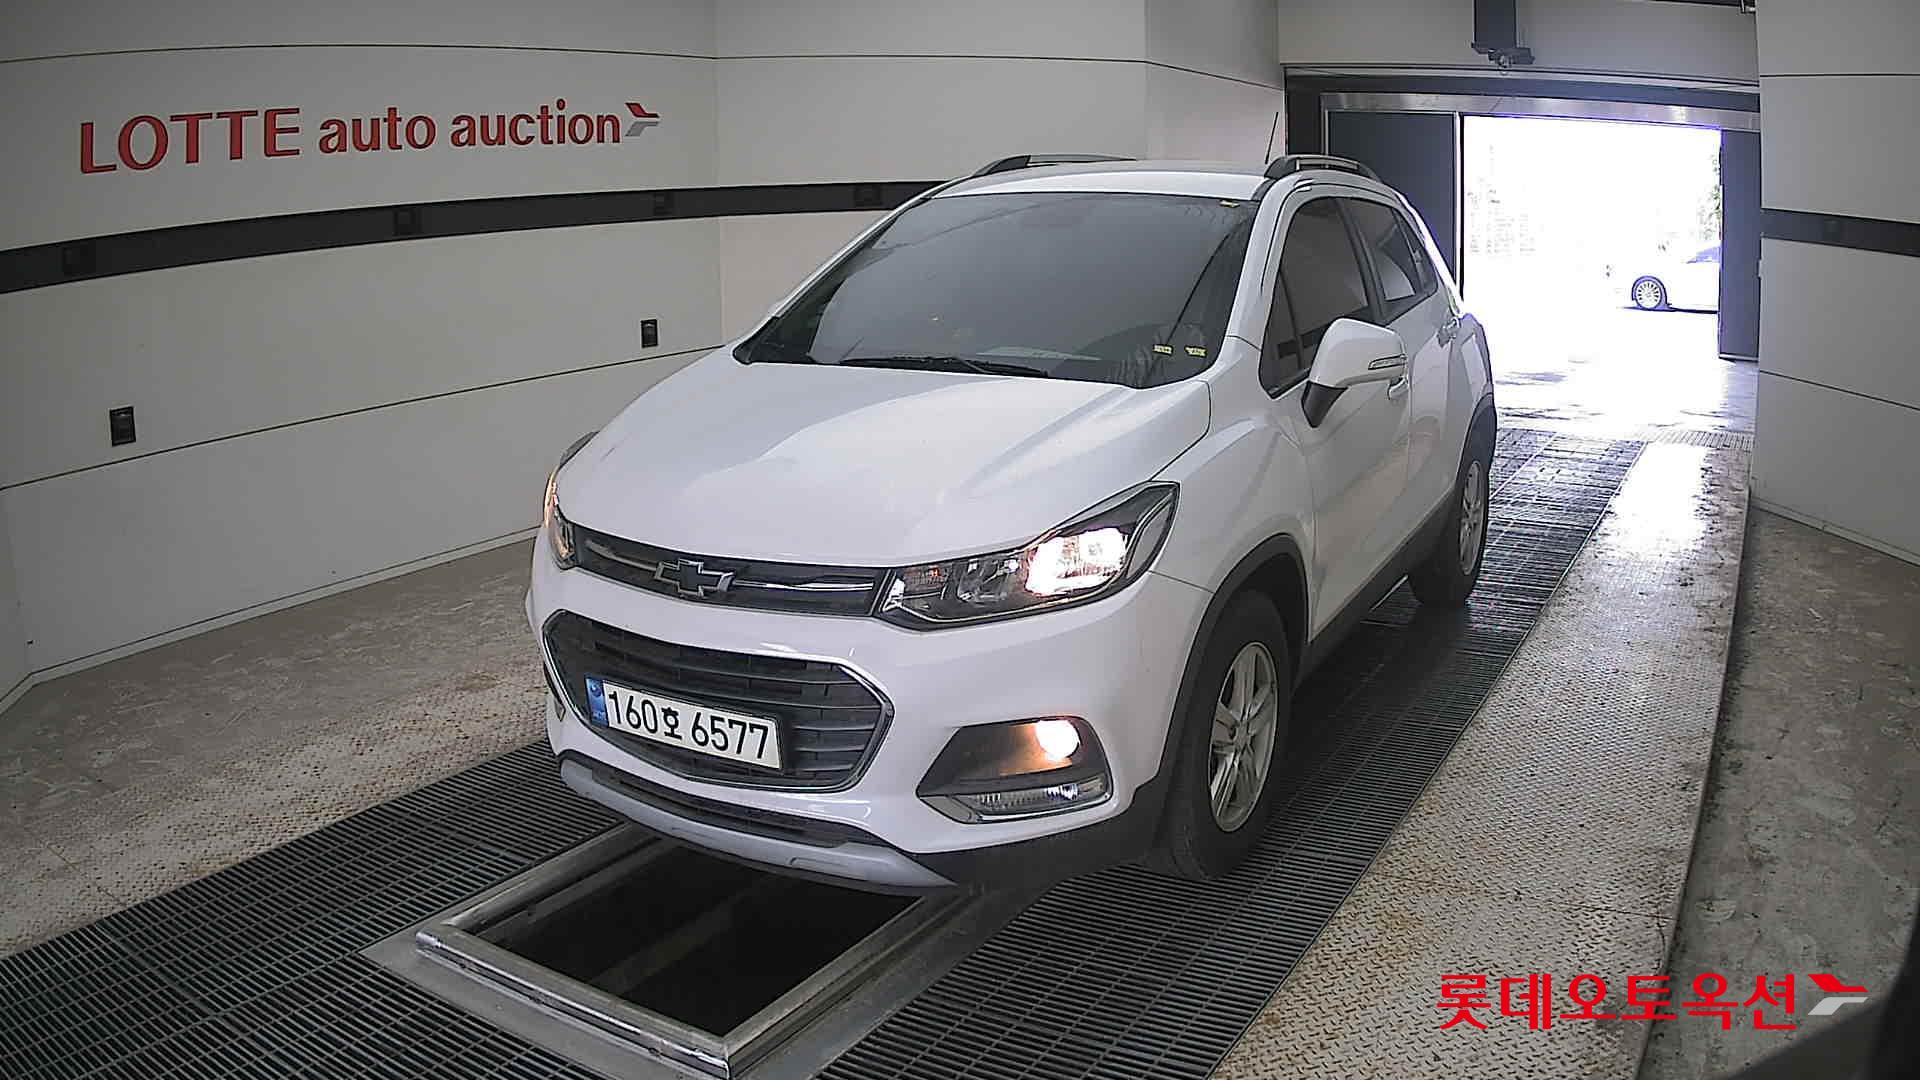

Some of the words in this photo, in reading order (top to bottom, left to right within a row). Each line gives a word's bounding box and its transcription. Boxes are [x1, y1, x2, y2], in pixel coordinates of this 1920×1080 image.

[80, 107, 300, 174] LOTTE
[318, 106, 437, 154] auto
[450, 98, 621, 148] auction
[608, 690, 683, 741] 160호
[691, 711, 769, 759] 6577
